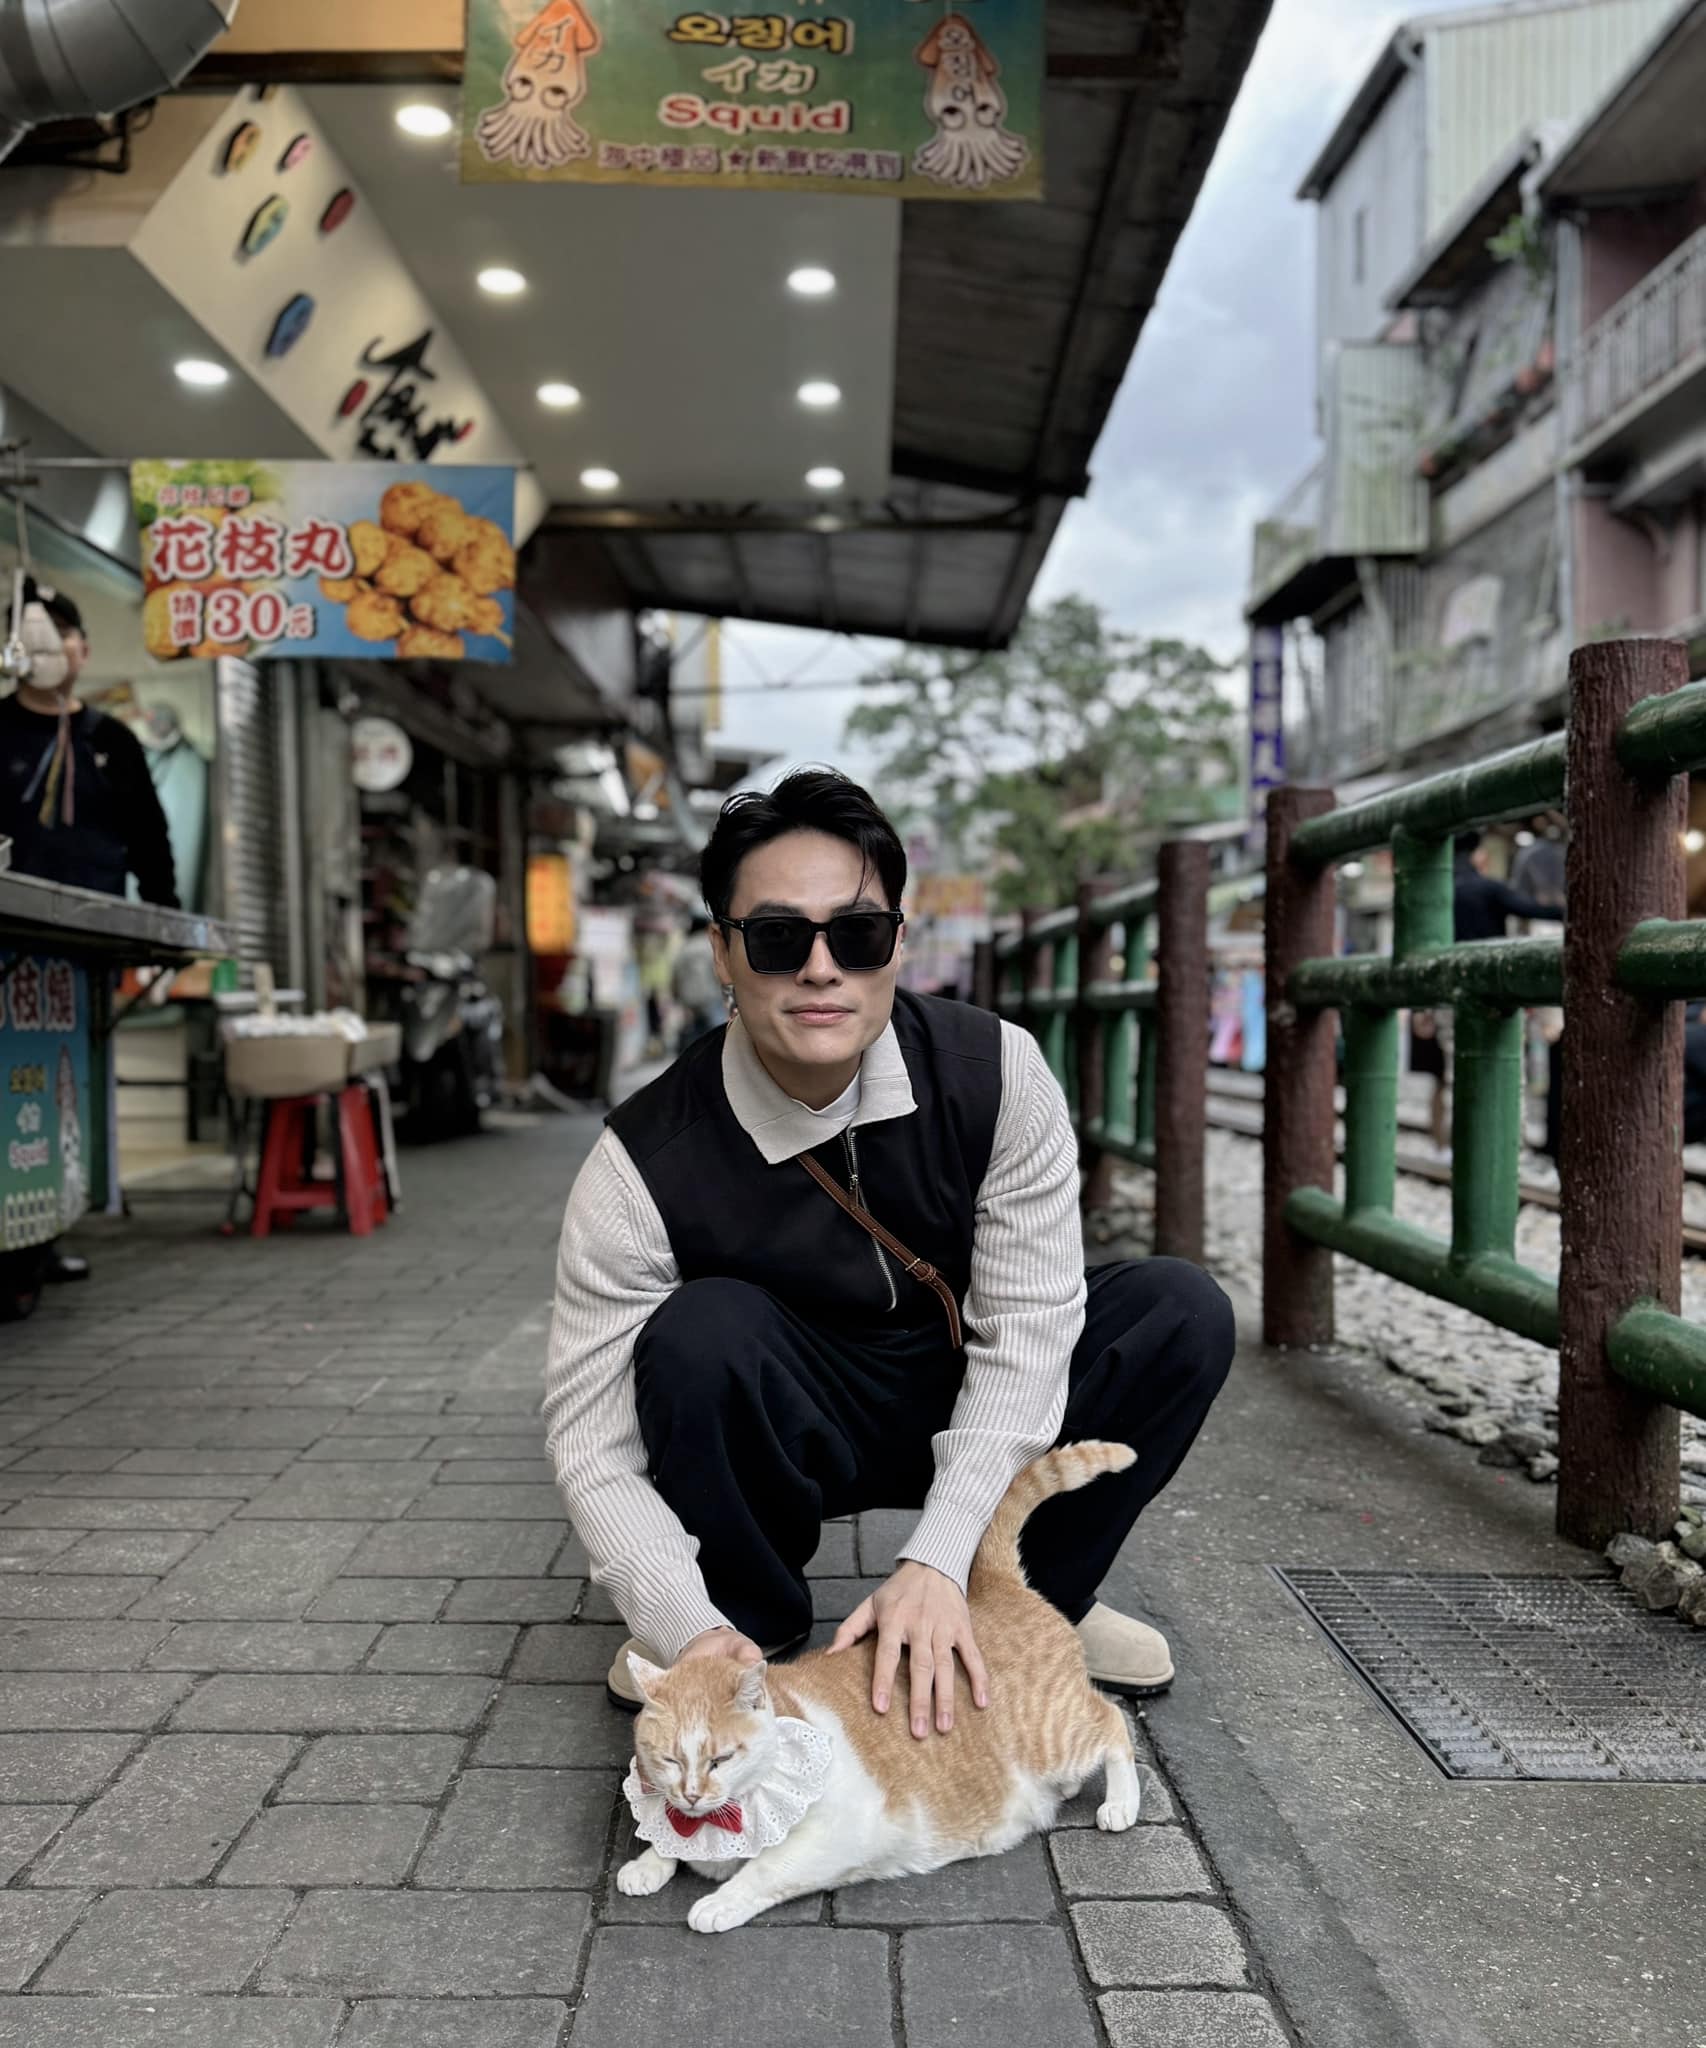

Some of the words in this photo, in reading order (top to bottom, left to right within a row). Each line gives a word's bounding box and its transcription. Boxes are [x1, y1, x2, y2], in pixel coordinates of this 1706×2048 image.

[535, 16, 573, 74] イカ
[704, 57, 815, 94] イカ
[661, 95, 850, 132] Squid
[150, 516, 352, 579] 花枝丸
